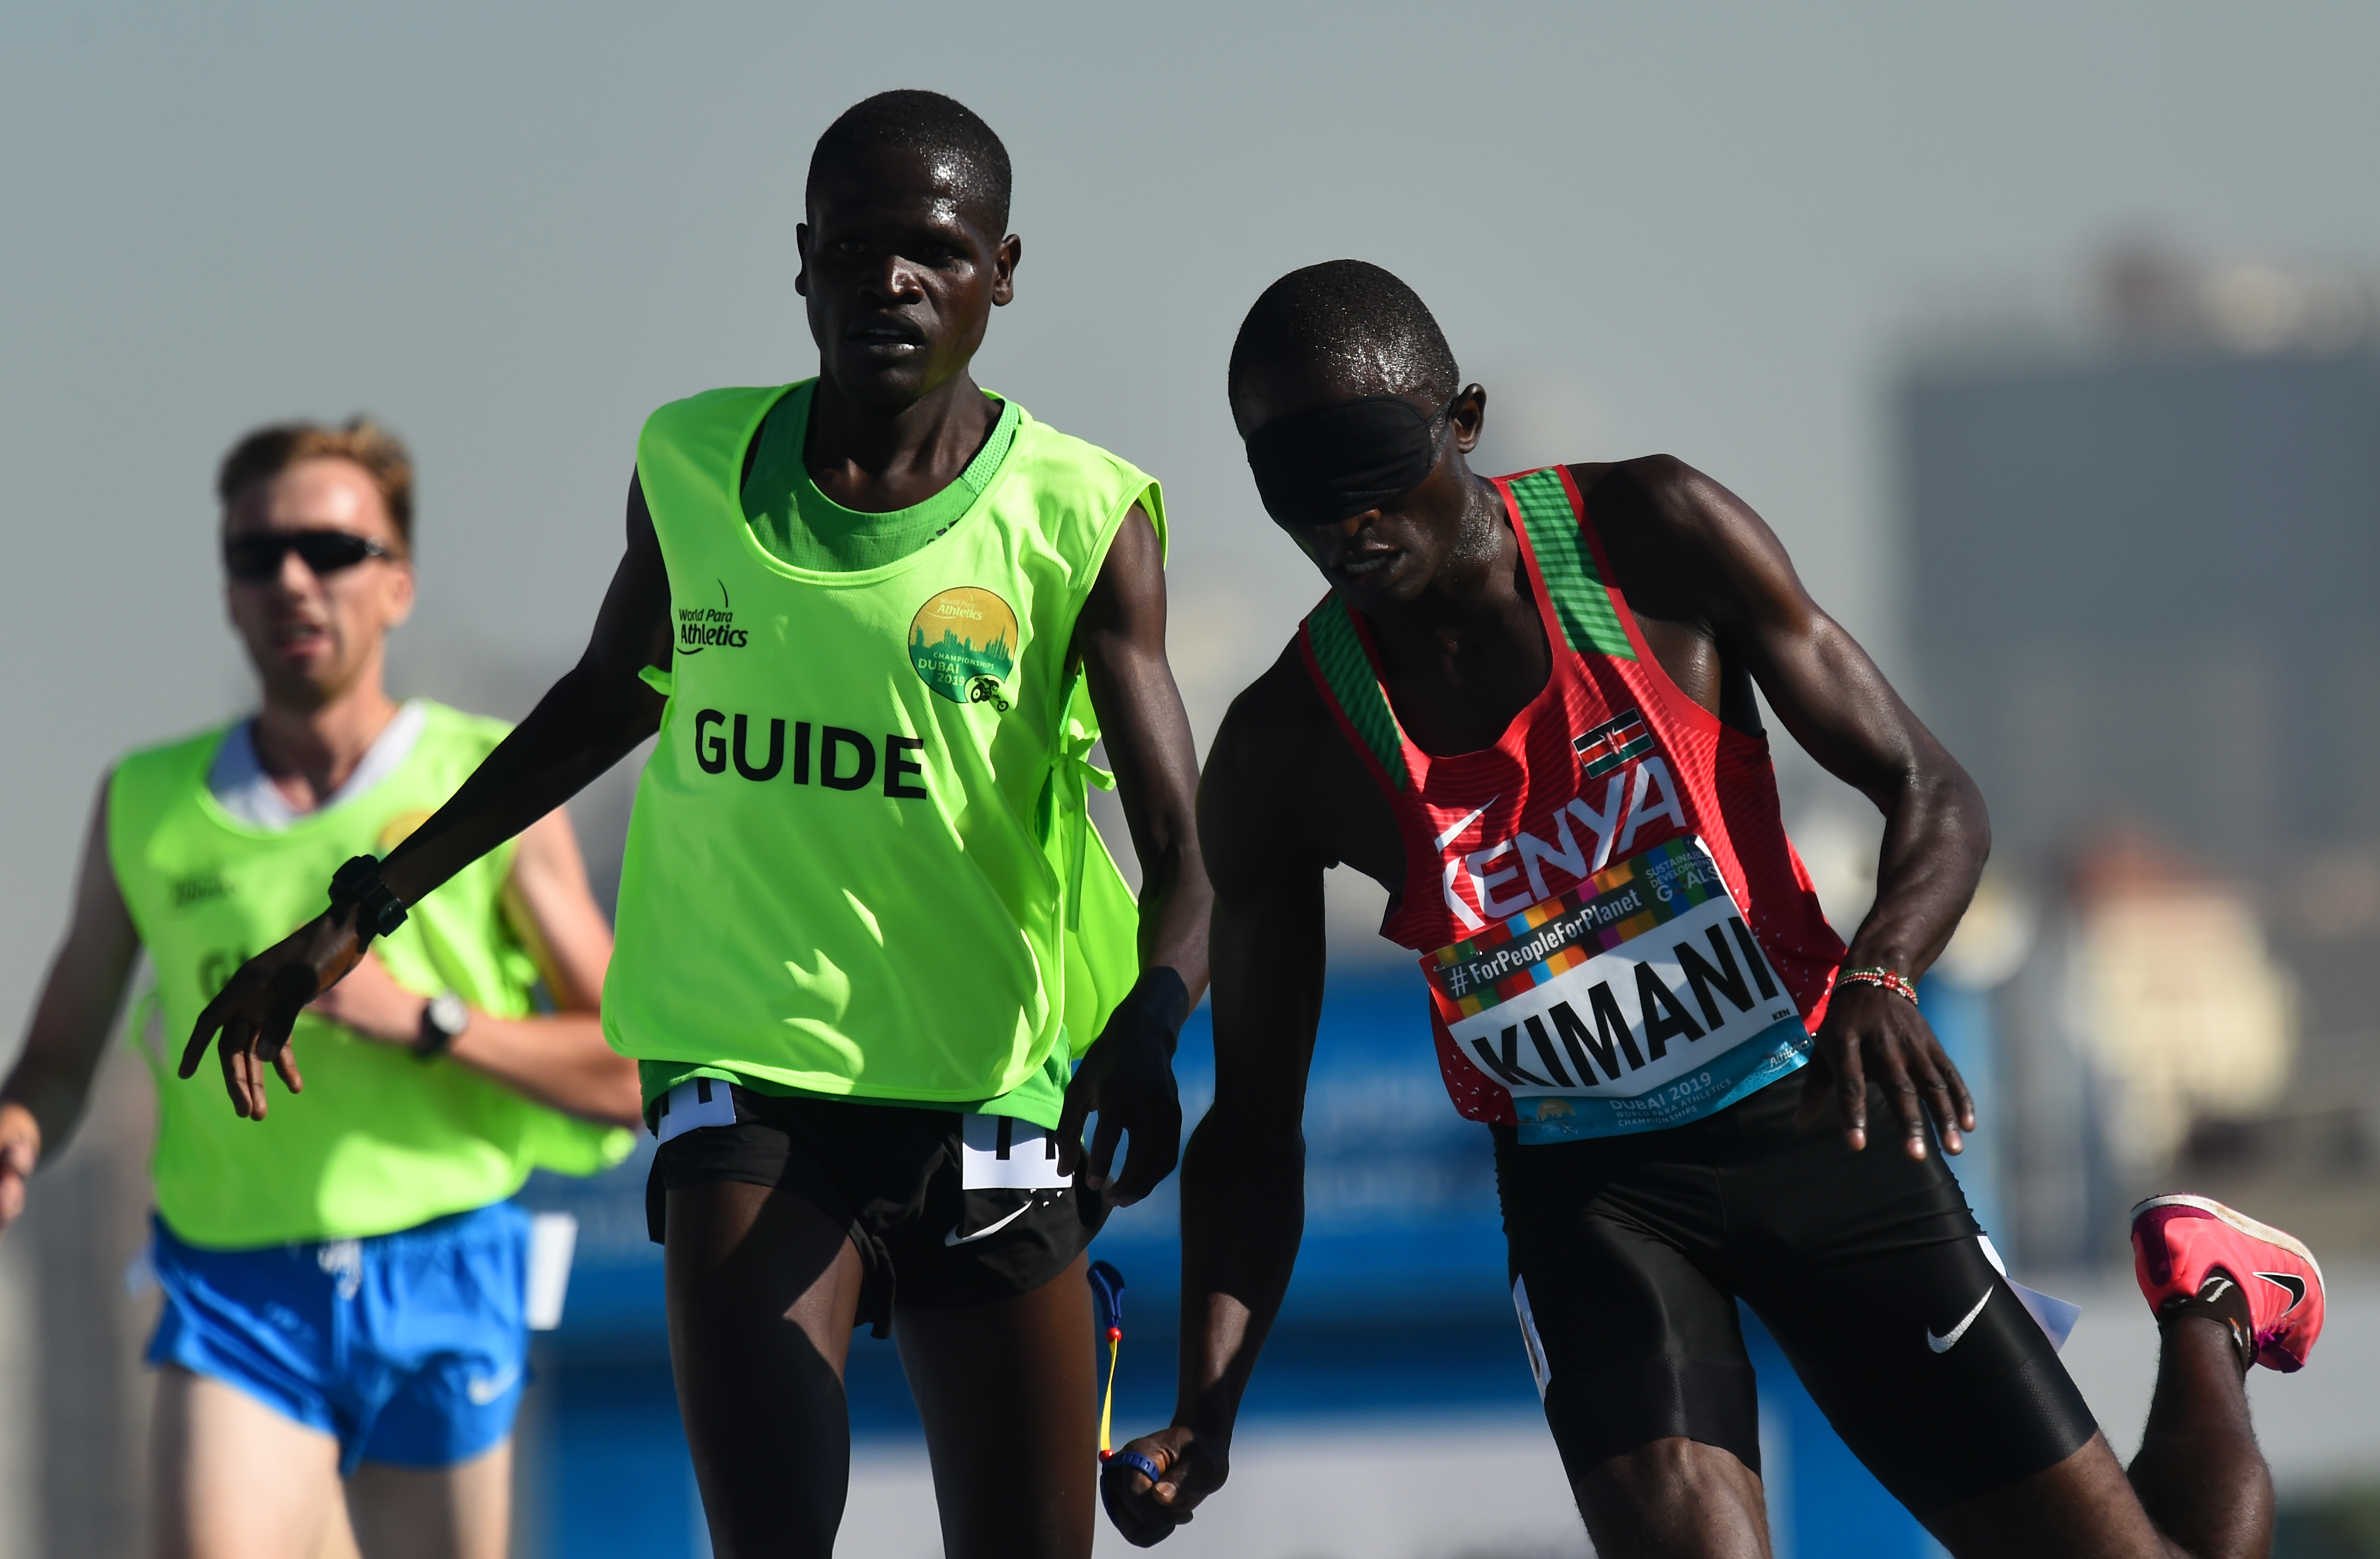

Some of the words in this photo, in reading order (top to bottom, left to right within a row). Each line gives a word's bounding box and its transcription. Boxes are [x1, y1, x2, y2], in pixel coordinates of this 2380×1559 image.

[679, 608, 704, 621] World
[706, 609, 733, 622] Para
[936, 604, 984, 620] Athletics
[681, 623, 749, 648] Athletics
[918, 658, 960, 674] DUBAI
[933, 652, 995, 670] CHAMPIONSHIPS
[937, 673, 965, 687] 2019
[695, 709, 927, 800] GUIDE
[1442, 756, 1687, 932] KENYA
[1646, 850, 1706, 879] SUSTAINABL
[1449, 889, 1643, 997] #ForPeopleForPlanet
[1471, 916, 1780, 1088] KIMANI
[1772, 1008, 1791, 1021] KEN
[1609, 1093, 1666, 1110] DUBAI
[1668, 1072, 1712, 1101] 2019
[1652, 1105, 1678, 1116] PARA
[1681, 1078, 1732, 1107] ATHLETICS
[1618, 1106, 1698, 1126] CHAMPIONSHIPS
